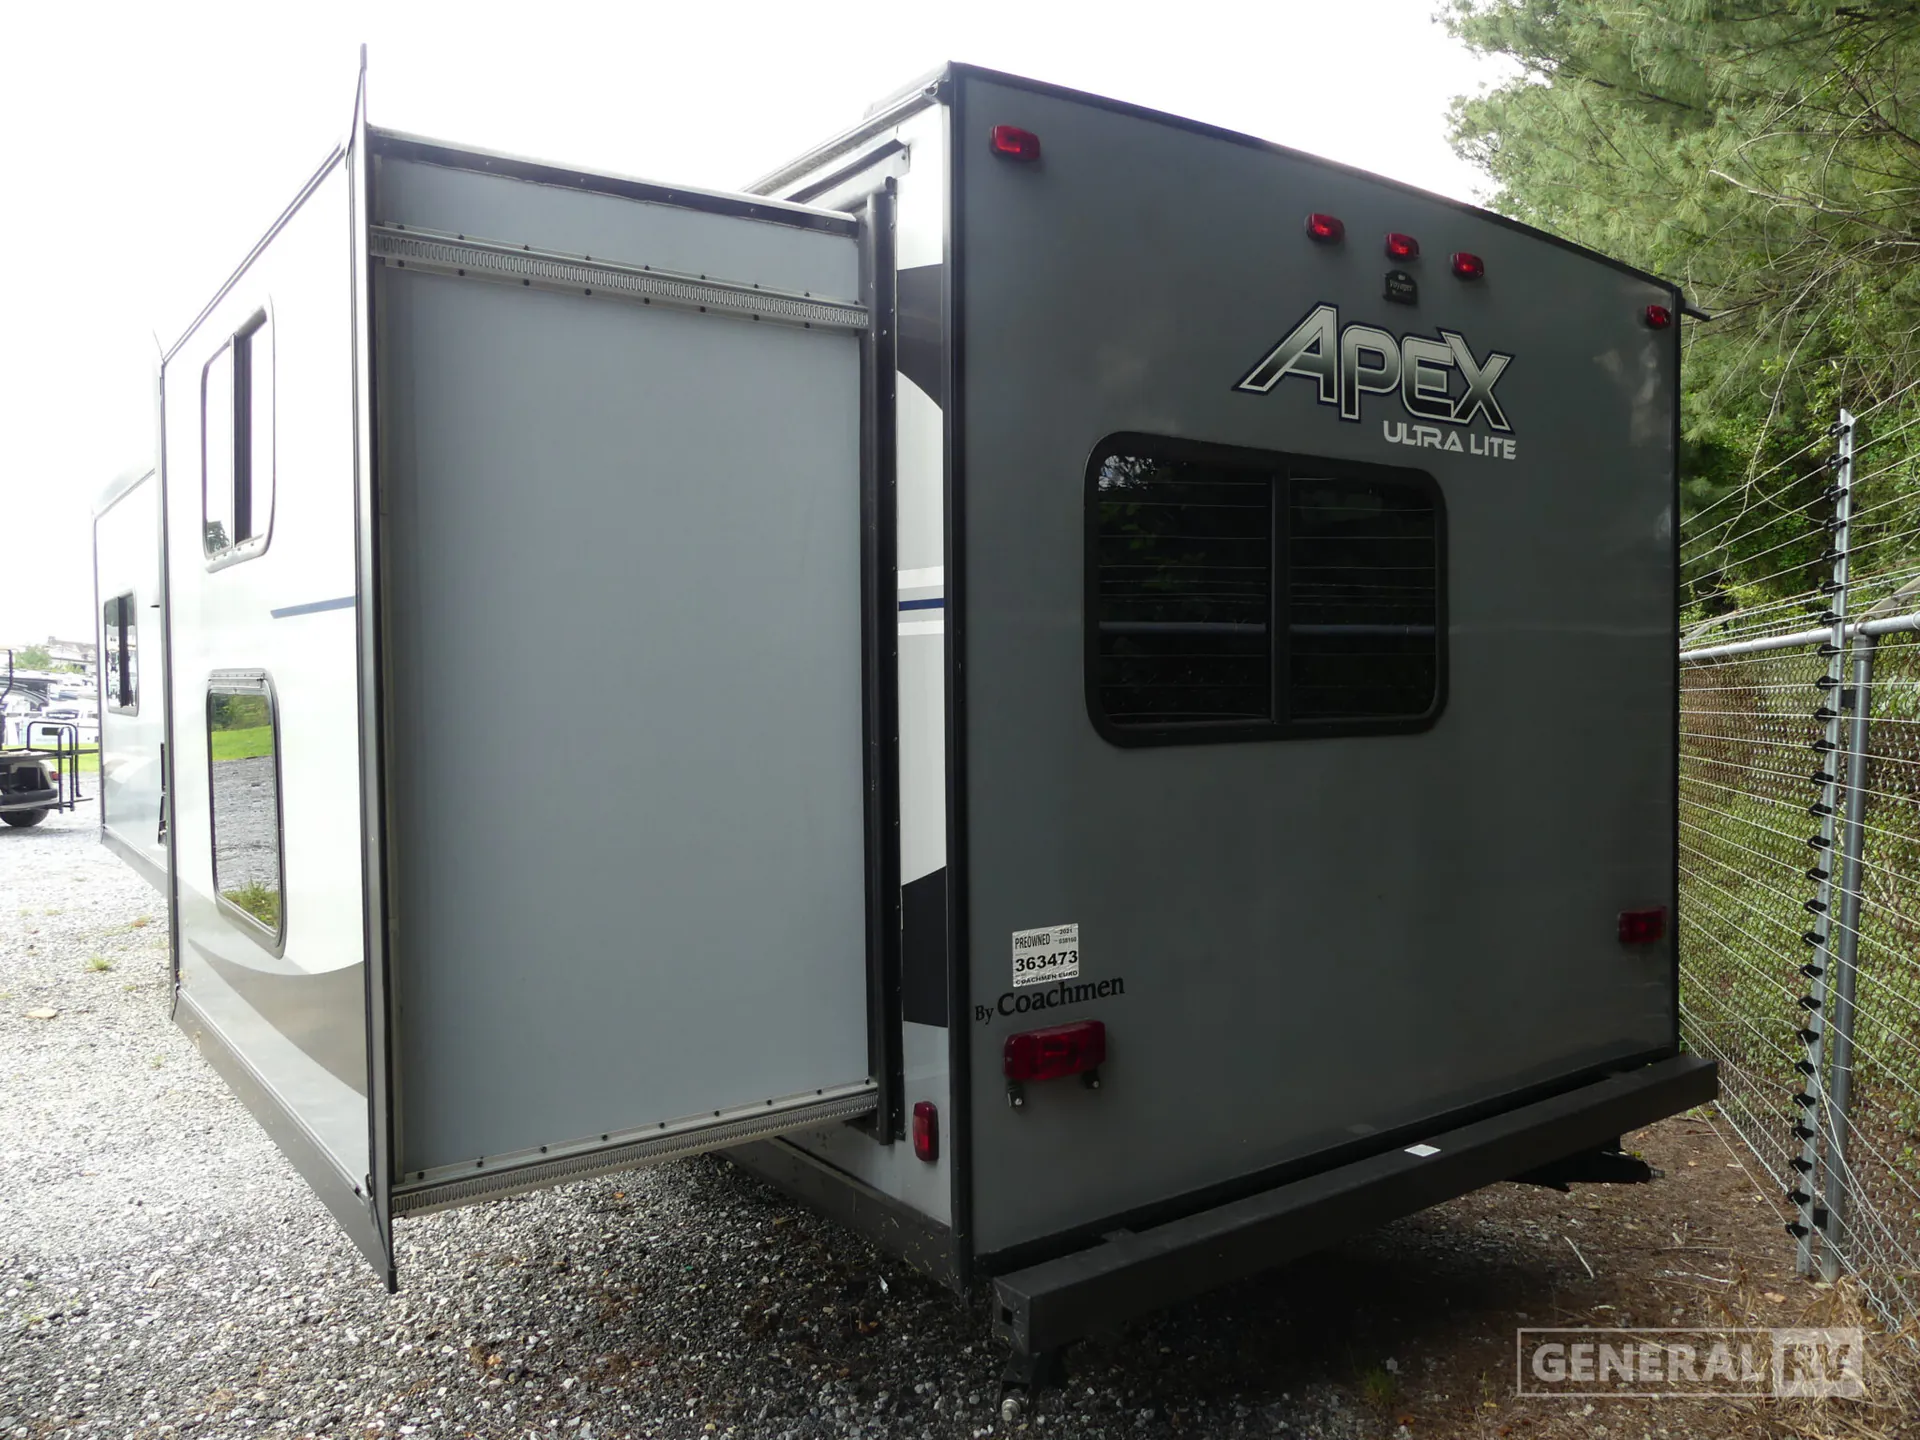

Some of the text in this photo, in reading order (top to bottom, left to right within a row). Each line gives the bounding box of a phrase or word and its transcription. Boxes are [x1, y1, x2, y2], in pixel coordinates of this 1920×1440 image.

[1383, 420, 1517, 460] ULTRA LITE
[1015, 933, 1051, 949] PREOWNED
[1015, 950, 1078, 972] 363473
[1015, 974, 1057, 985] COACHMEN
[975, 977, 1125, 1025] By Coachmen
